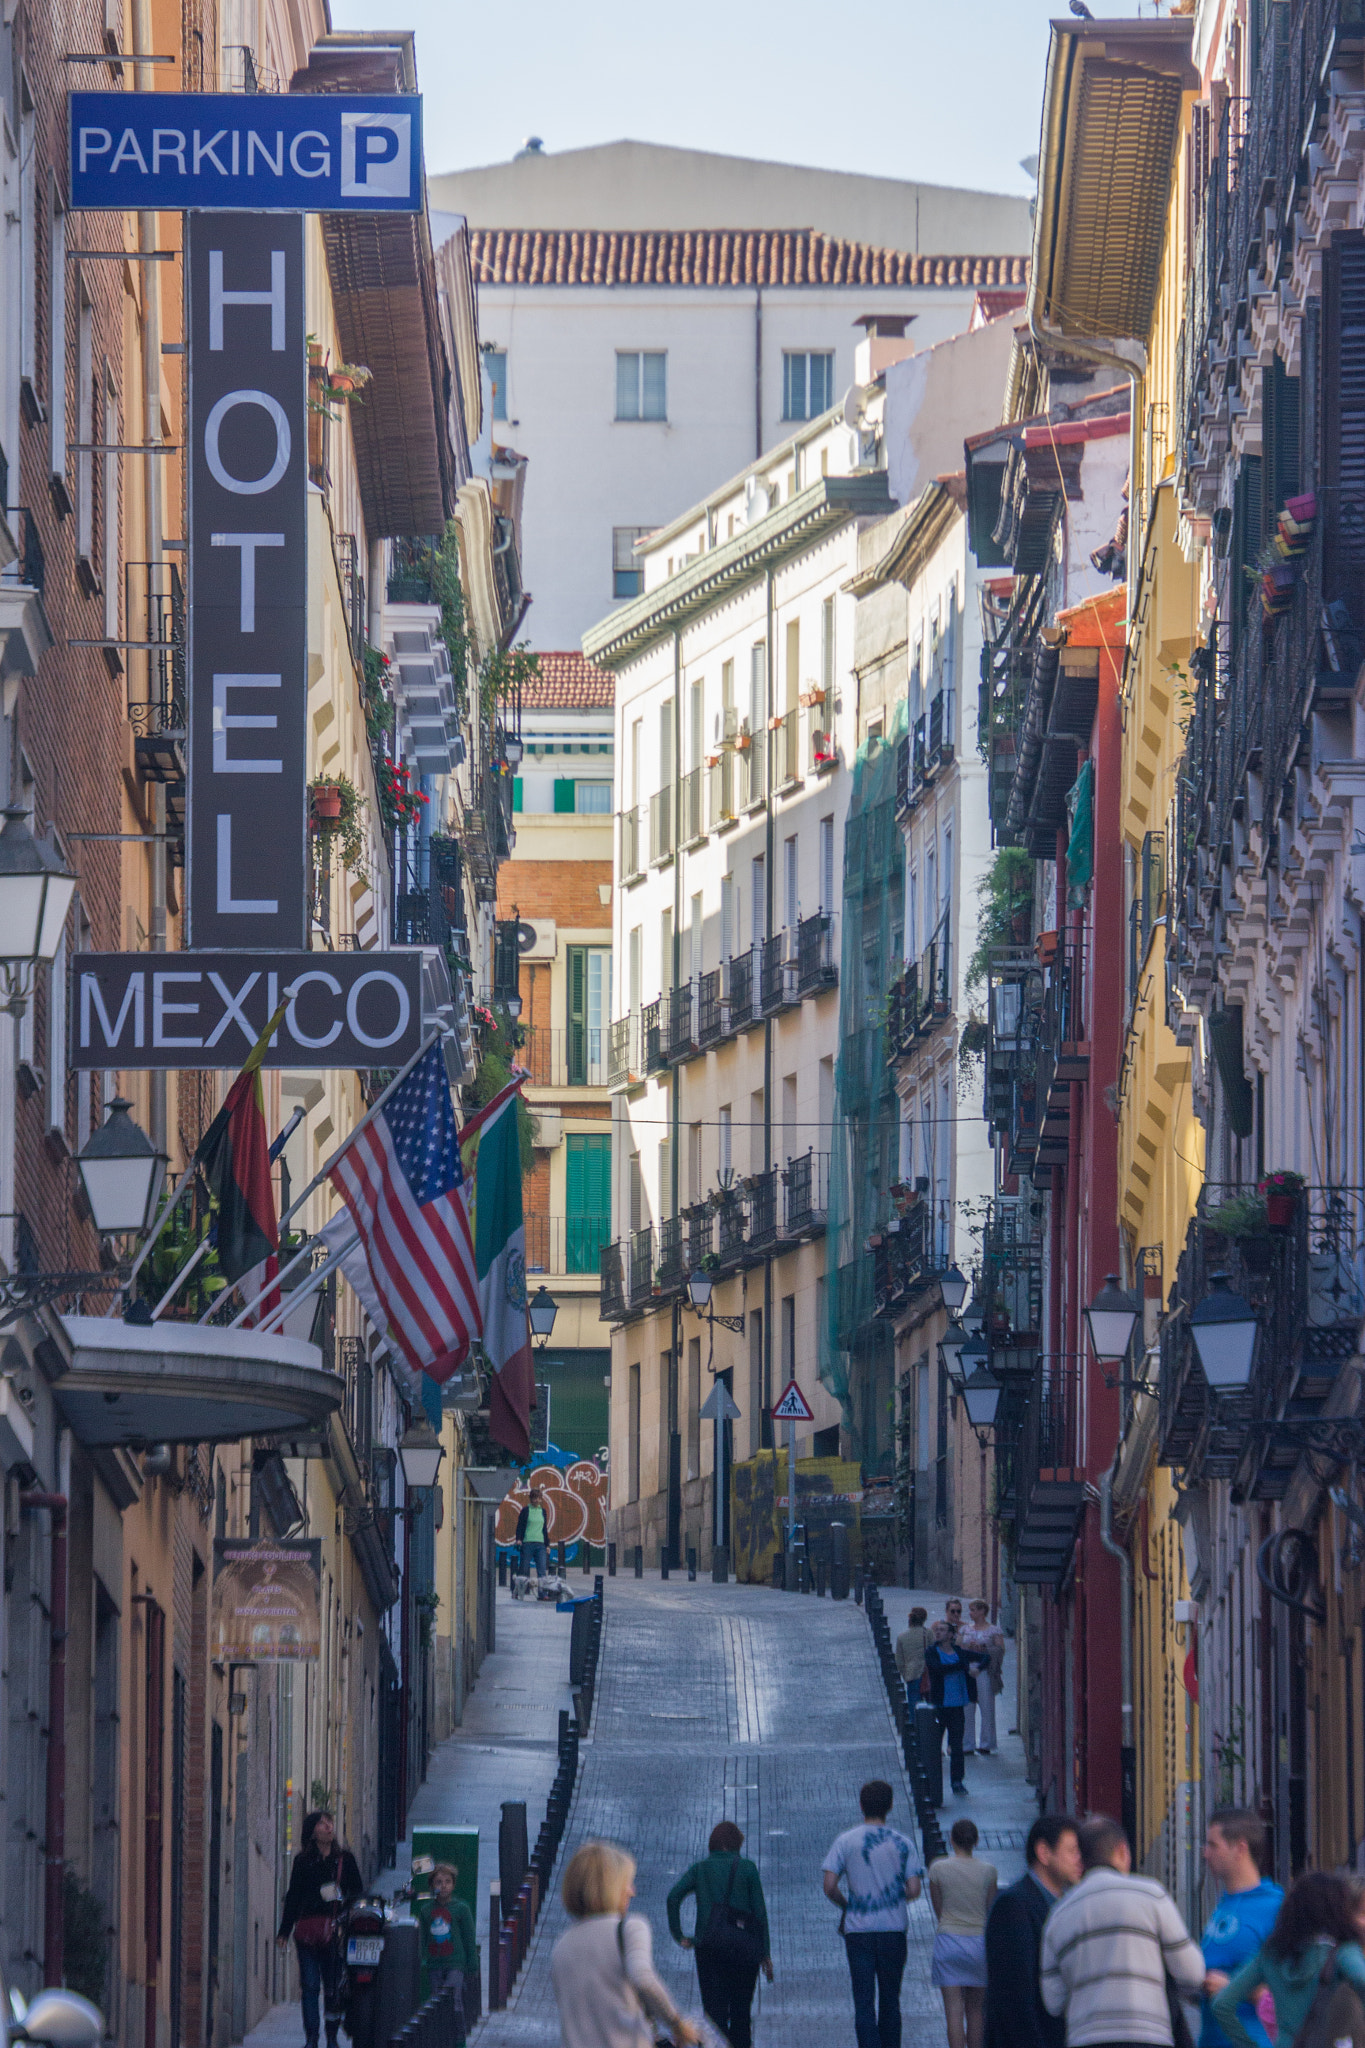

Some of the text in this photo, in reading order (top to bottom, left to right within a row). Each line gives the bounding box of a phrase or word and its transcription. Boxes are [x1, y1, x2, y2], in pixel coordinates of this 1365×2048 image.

[79, 125, 399, 185] PARKING P
[204, 250, 292, 914] HOTEL
[80, 970, 410, 1048] MEXICO
